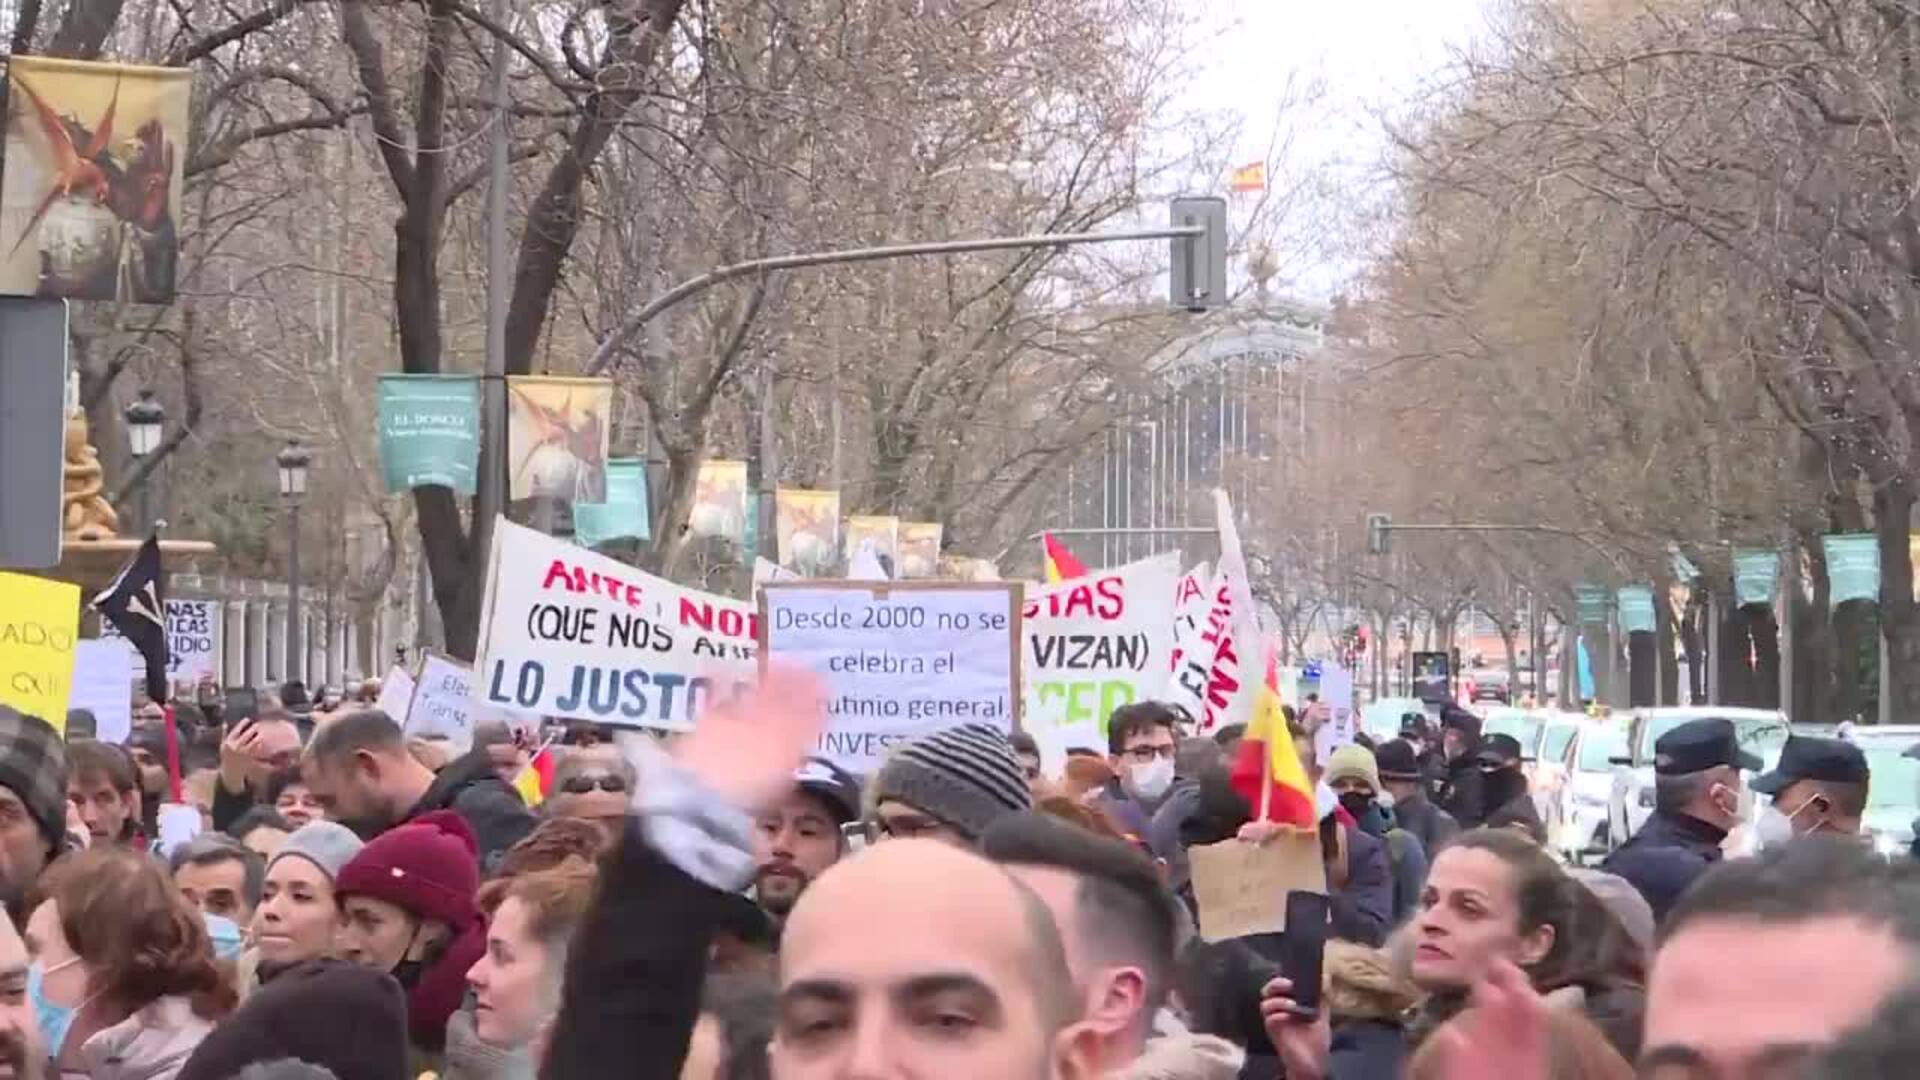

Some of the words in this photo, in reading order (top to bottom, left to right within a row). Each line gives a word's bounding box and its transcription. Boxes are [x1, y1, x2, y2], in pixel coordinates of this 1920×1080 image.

[607, 613, 674, 653] NOS
[776, 606, 852, 630] Desde
[861, 606, 926, 629] 2000
[938, 613, 970, 630] no
[978, 613, 1006, 630] se
[829, 648, 924, 674] celebra
[933, 651, 954, 673] el
[488, 659, 545, 709] LO
